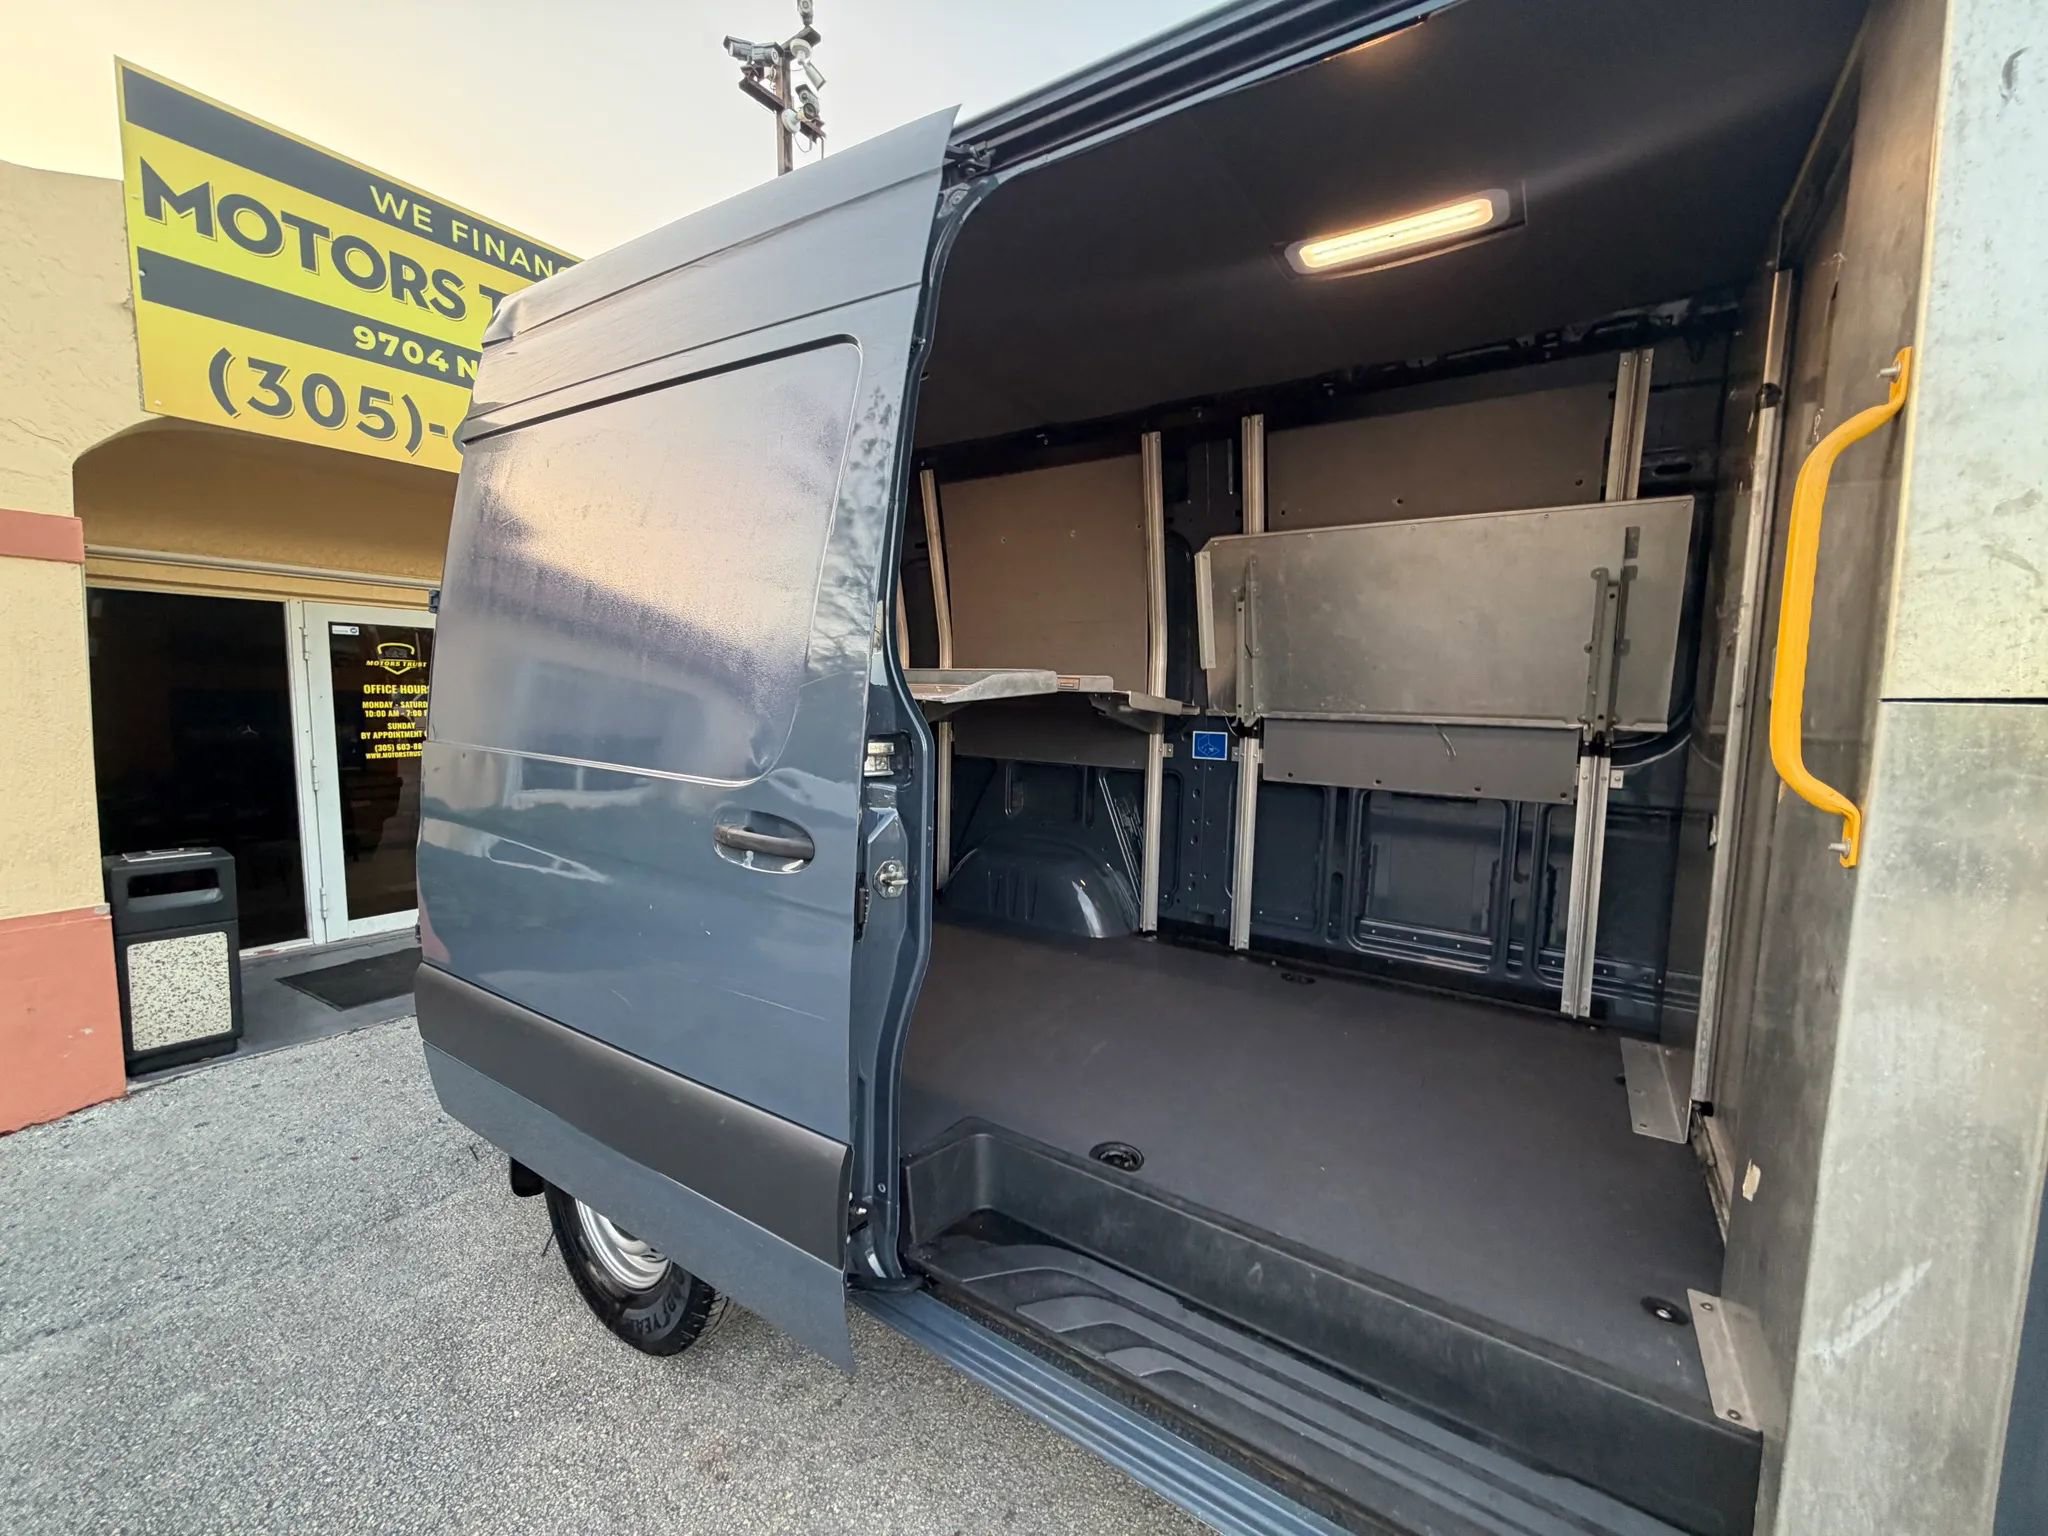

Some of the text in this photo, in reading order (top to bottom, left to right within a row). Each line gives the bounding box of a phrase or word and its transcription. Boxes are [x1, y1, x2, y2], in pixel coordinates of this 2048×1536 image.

[370, 185, 569, 277] WE FINAN
[140, 156, 467, 321] MOTORS
[353, 324, 449, 373] 9704
[363, 684, 398, 694] OFFICE
[362, 701, 393, 709] MONDAY
[387, 722, 416, 730] SUNDAY
[373, 730, 423, 739] APPOINTMENT
[374, 743, 395, 753] (305)
